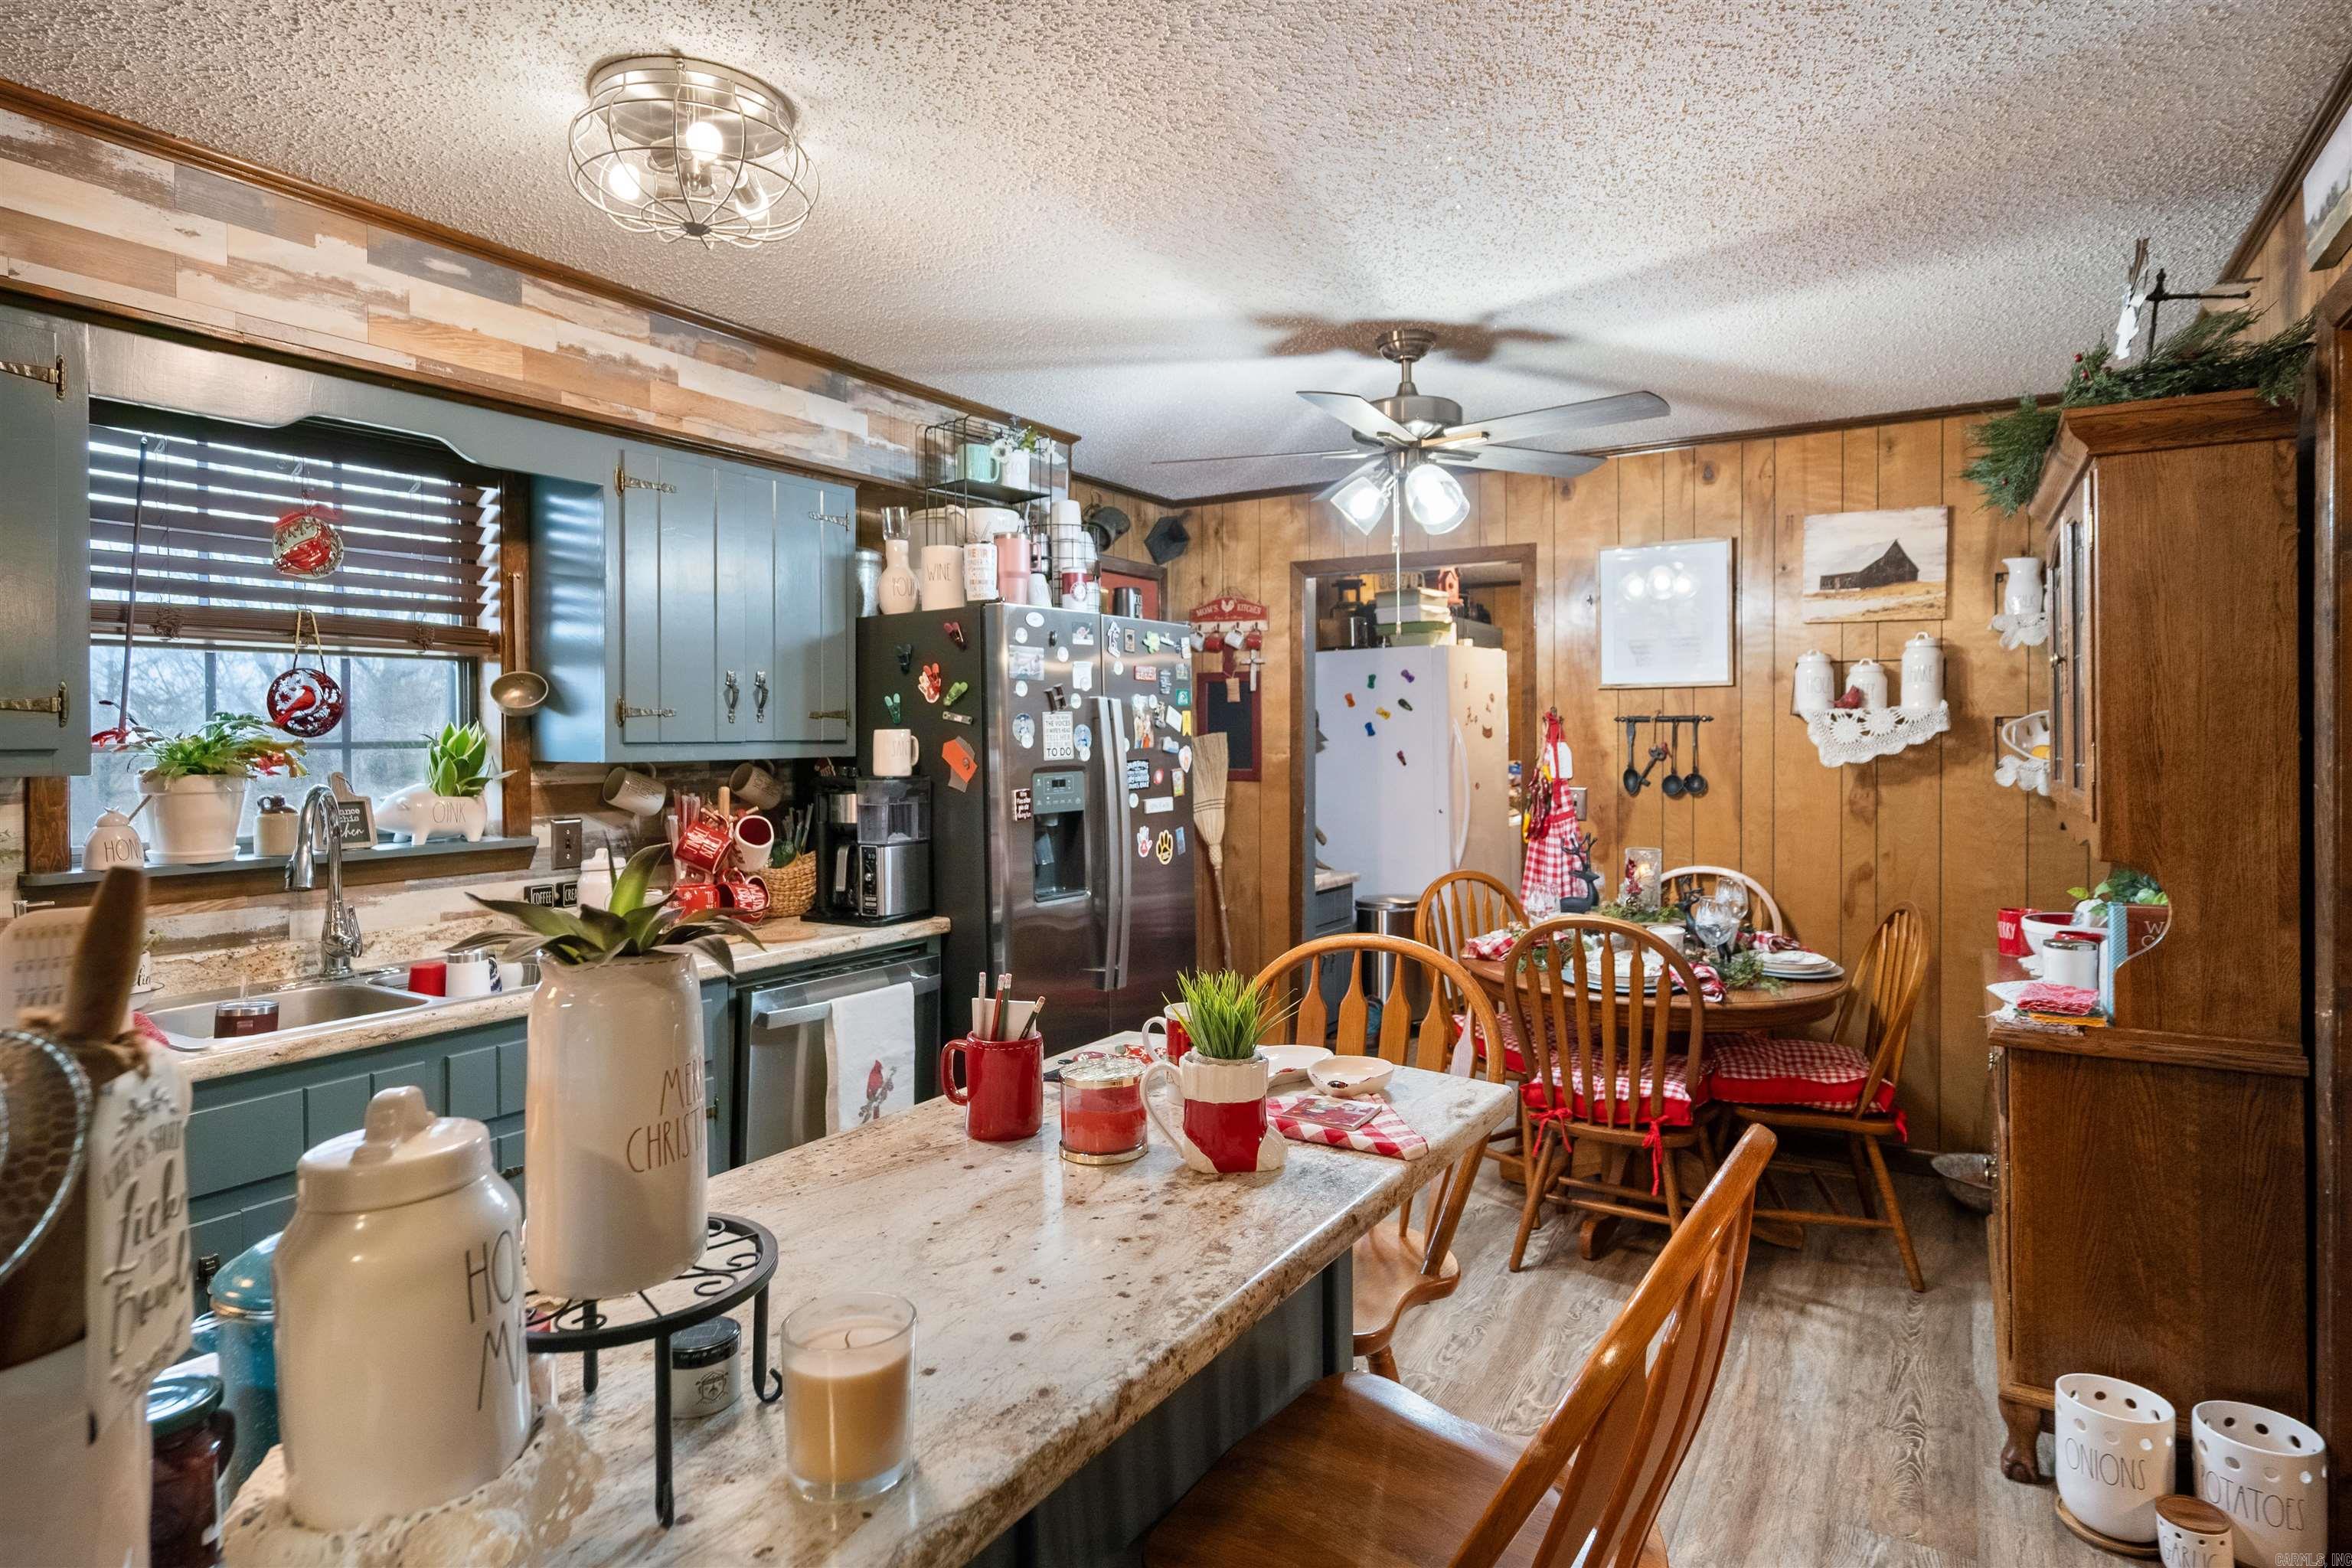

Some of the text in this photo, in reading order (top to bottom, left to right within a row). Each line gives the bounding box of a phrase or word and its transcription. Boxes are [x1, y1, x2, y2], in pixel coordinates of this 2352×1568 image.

[926, 563, 951, 582] WINE
[1196, 603, 1263, 617] MOM'S KITCHEN
[1047, 746, 1072, 757] TO DO
[433, 802, 466, 823] OINK
[683, 826, 710, 854] JINGLE
[699, 834, 723, 859] BELLS
[532, 890, 552, 905] COFFEE
[736, 886, 754, 910] MERRY
[2065, 1438, 2146, 1491] ONIONS
